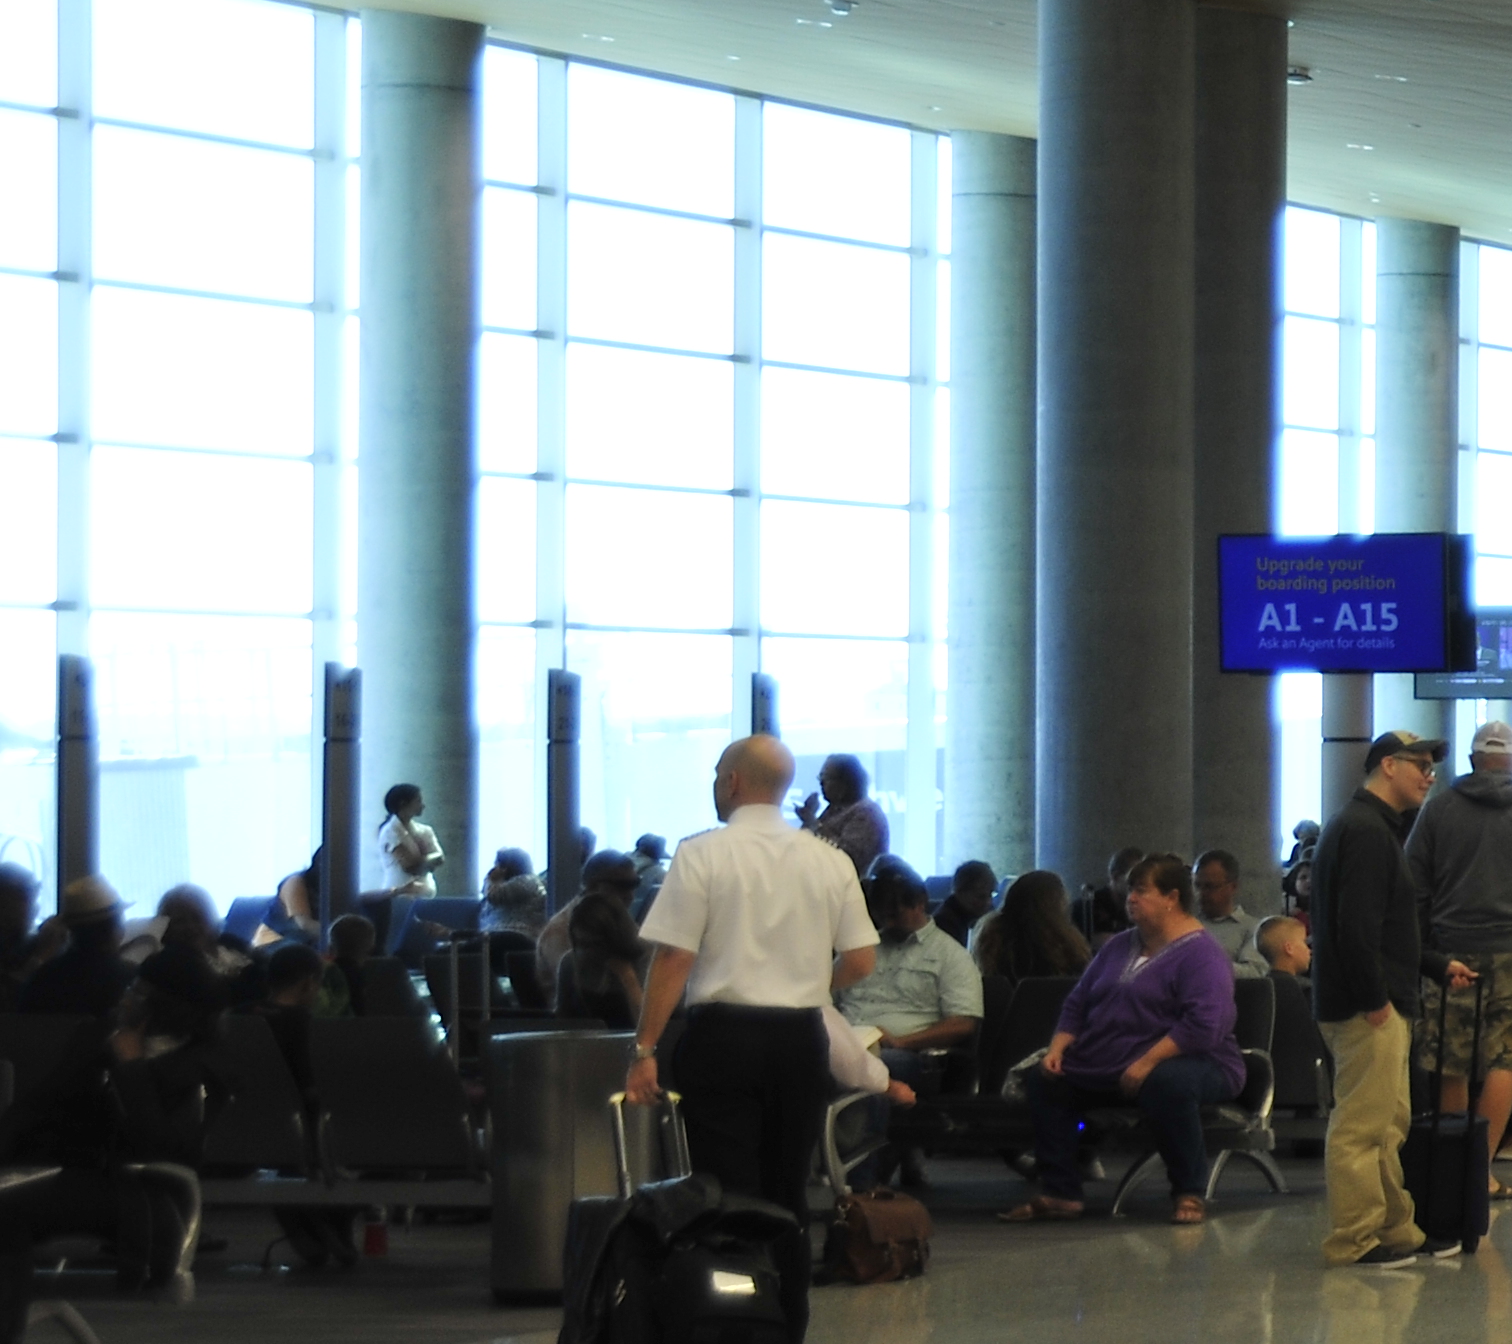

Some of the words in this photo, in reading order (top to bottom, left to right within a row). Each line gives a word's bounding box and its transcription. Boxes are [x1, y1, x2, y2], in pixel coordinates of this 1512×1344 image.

[1256, 556, 1324, 575] Upgrade
[1327, 558, 1365, 574] your
[1256, 575, 1328, 594] boarding
[1332, 575, 1396, 594] position
[1258, 602, 1302, 632] A1
[1333, 602, 1399, 632] A15
[1258, 637, 1280, 649] Ask
[1282, 640, 1297, 649] an
[1299, 637, 1335, 652] Agent
[1337, 637, 1354, 649] for
[1356, 637, 1396, 649] details
